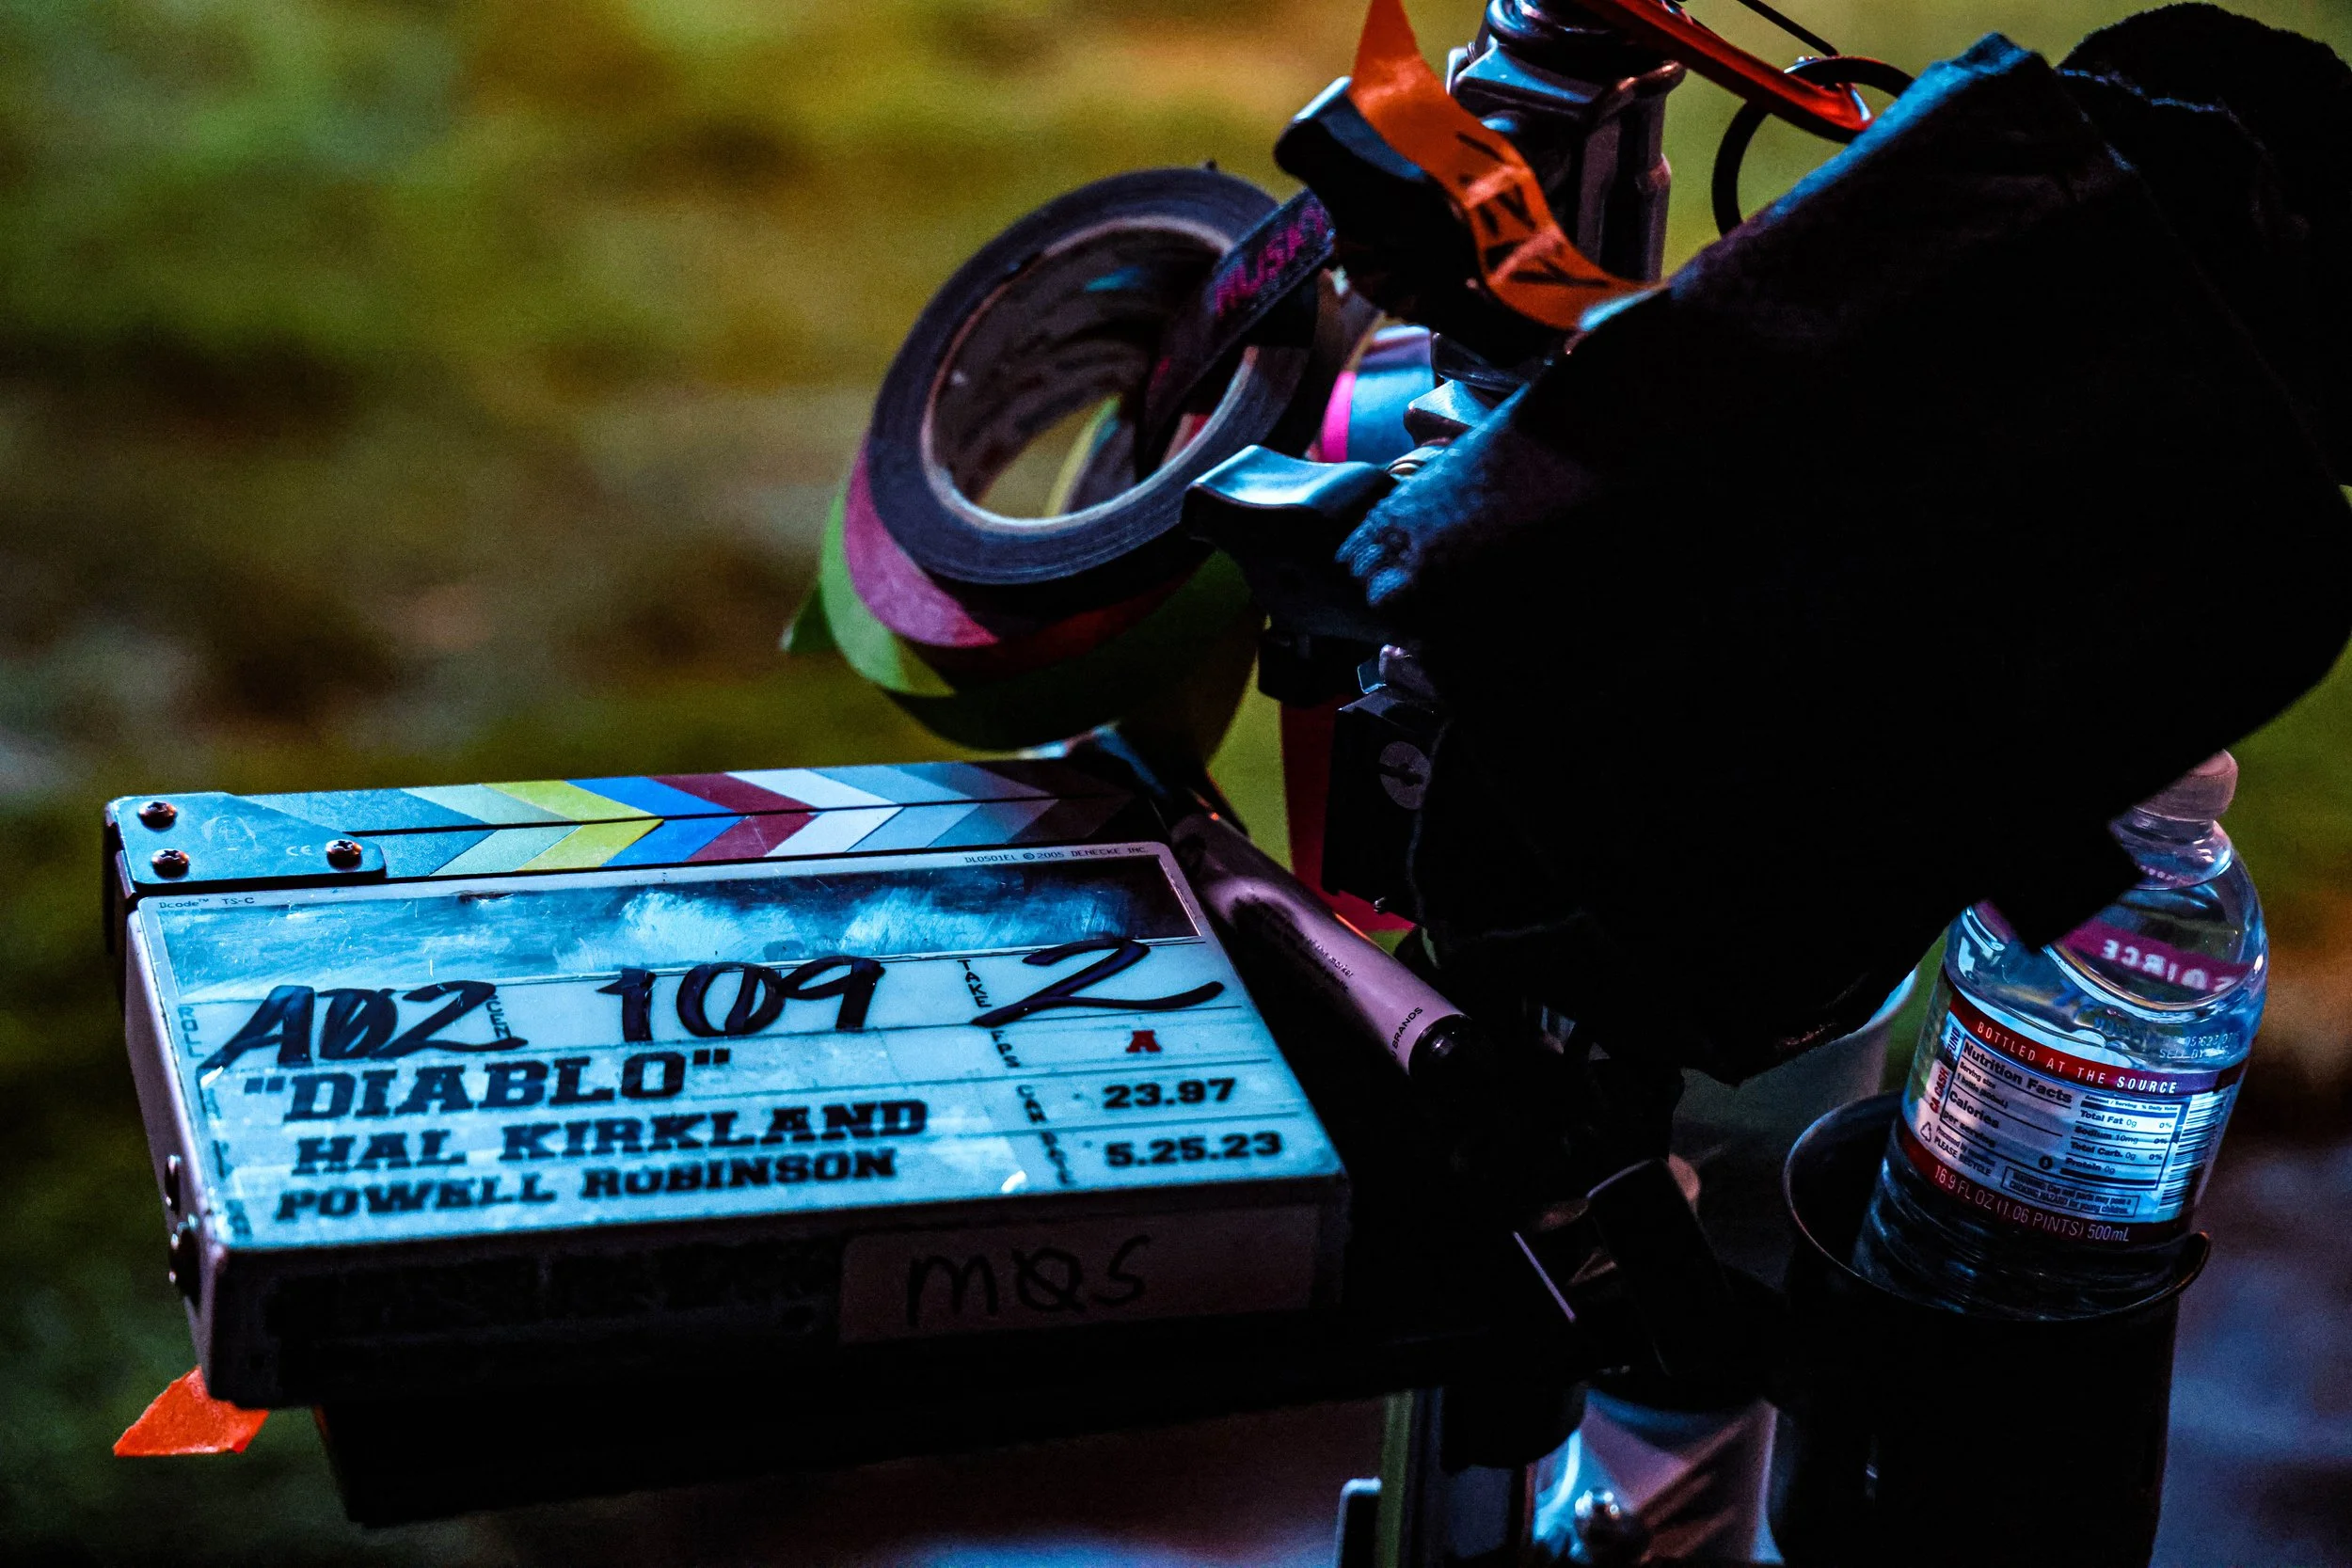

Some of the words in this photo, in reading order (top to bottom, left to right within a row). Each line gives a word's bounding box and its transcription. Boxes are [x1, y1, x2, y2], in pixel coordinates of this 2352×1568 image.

[1071, 847, 1120, 858] DENECKE
[221, 896, 255, 905] TS-C
[957, 958, 993, 1008] TAKE
[969, 937, 1226, 1028] 2
[1328, 957, 1354, 978] marker
[596, 955, 886, 1042] 109
[177, 1006, 204, 1058] ROLL
[485, 994, 512, 1039] CEN
[1392, 1007, 1423, 1049] BRANDS
[1125, 1029, 1162, 1053] A
[1977, 1022, 2036, 1061] BOTTLED
[2046, 1057, 2065, 1073] AT
[2077, 1067, 2106, 1084] THE
[2117, 1076, 2178, 1094] SOURCE
[244, 1049, 730, 1122] "DIABLO"
[1934, 1067, 1948, 1099] CASH
[1959, 1061, 1982, 1083] Serving
[1982, 1077, 1997, 1089] size
[1963, 1040, 2023, 1085] Nutrition
[2026, 1077, 2073, 1103] Facts
[1102, 1077, 1237, 1110] 23.97
[1948, 1090, 2000, 1129] Calories
[1943, 1110, 1959, 1125] per
[2074, 1125, 2112, 1141] Sodium
[2115, 1133, 2138, 1145] 10mg
[2080, 1109, 2105, 1122] Total
[2107, 1116, 2123, 1125] Fat
[2126, 1118, 2137, 1128] 0g
[292, 1128, 467, 1177] HAL
[498, 1099, 928, 1163] KIRKLAND
[1104, 1131, 1285, 1168] 5.25.23
[1933, 1135, 1958, 1159] PLEASE
[2071, 1141, 2095, 1153] Total
[2124, 1151, 2137, 1161] 0g
[2039, 1155, 2053, 1170] 0
[2065, 1157, 2102, 1172] Protein
[2105, 1164, 2116, 1175] 0g
[274, 1171, 557, 1221] POWELL
[580, 1148, 898, 1199] ROBINSON
[1934, 1165, 1956, 1190] 16.9
[1957, 1180, 1971, 1199] FL
[1975, 1189, 1994, 1210] OZ
[1996, 1199, 2030, 1223] (1.06
[2032, 1212, 2084, 1237] PINTS)
[2088, 1224, 2130, 1242] 500mL
